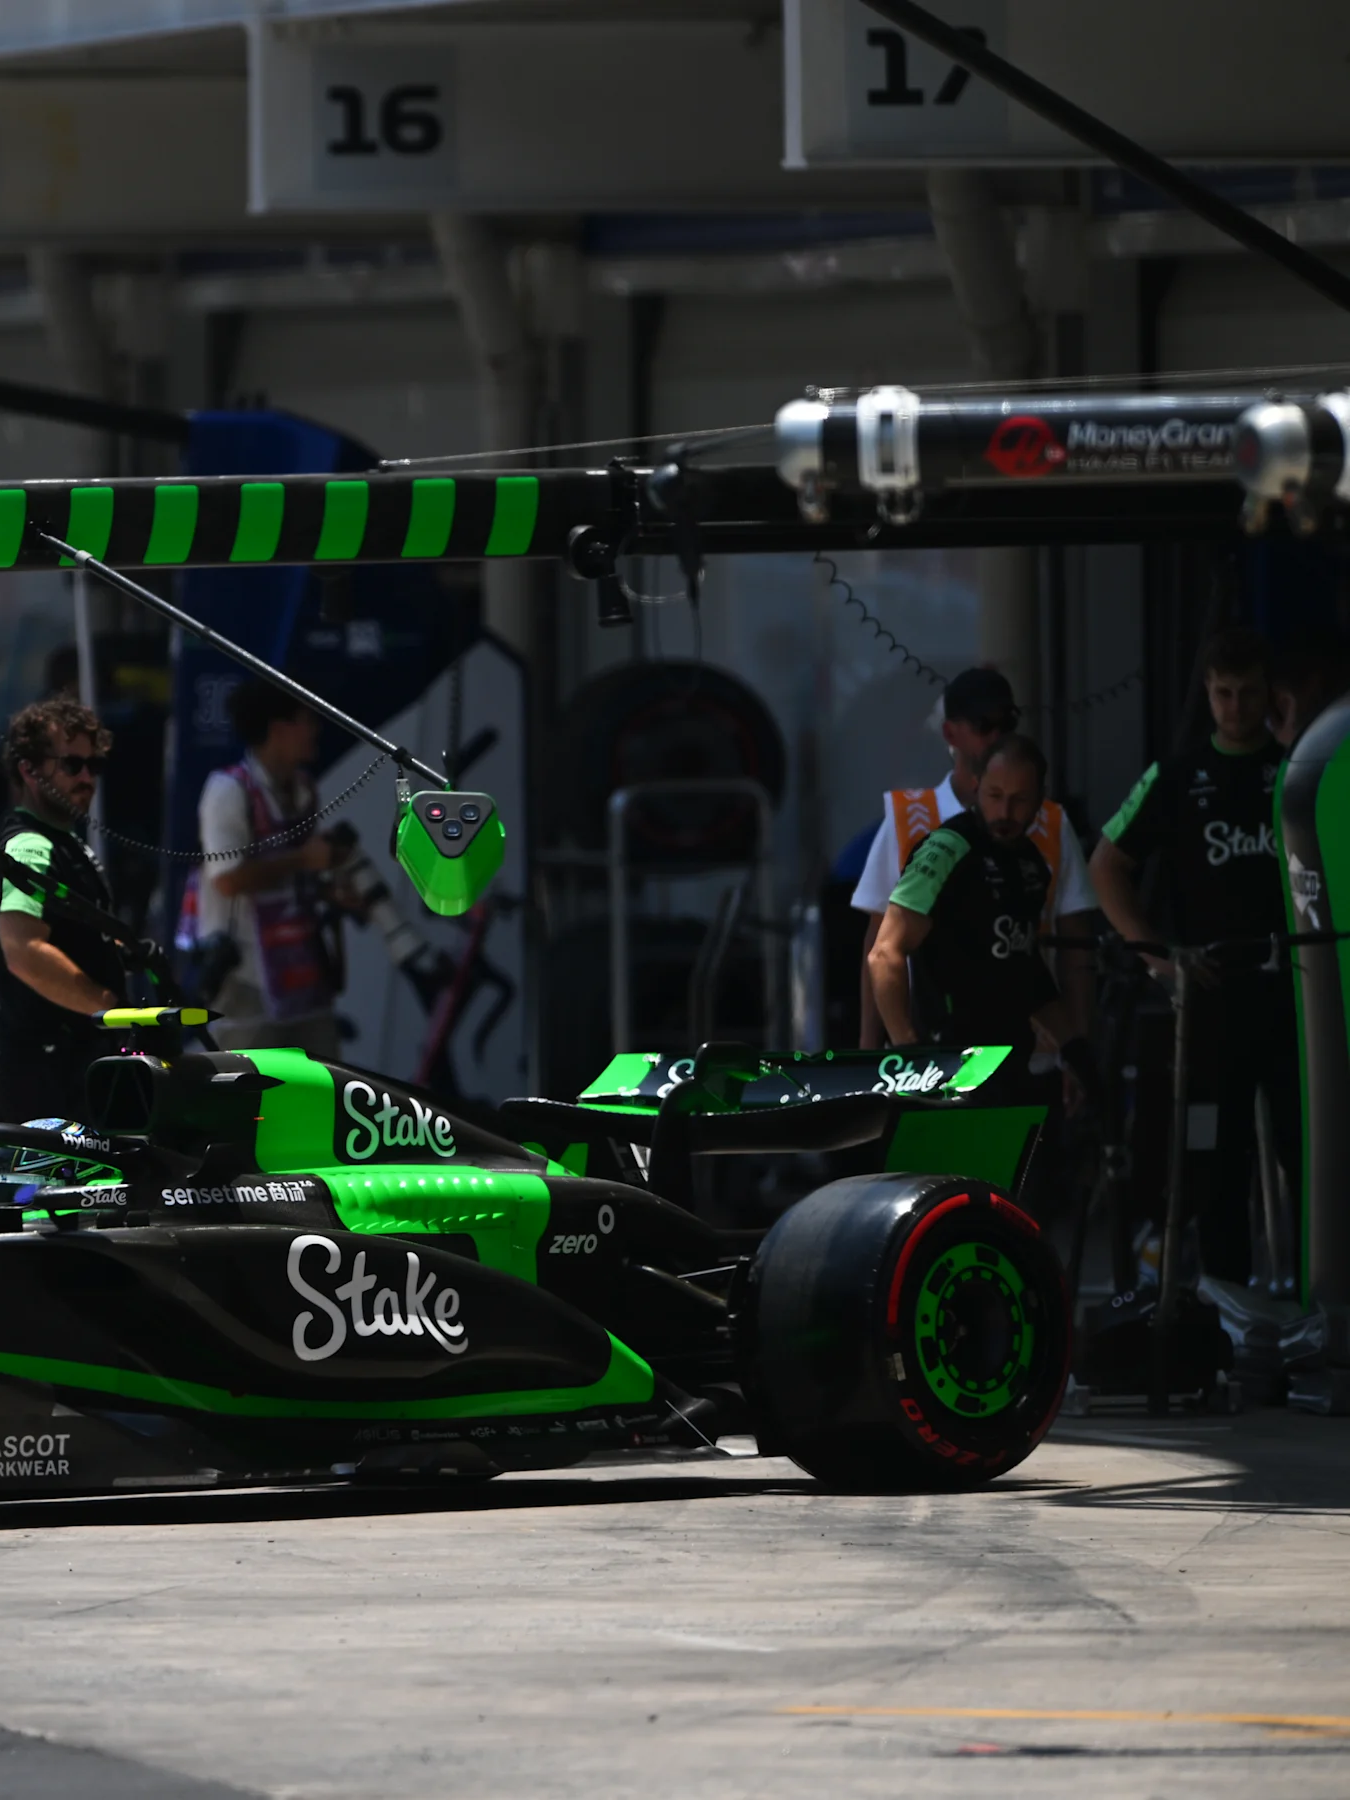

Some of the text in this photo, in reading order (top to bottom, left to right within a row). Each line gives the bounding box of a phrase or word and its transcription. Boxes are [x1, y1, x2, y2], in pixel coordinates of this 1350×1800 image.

[866, 26, 987, 106] 17
[327, 84, 443, 155] 16
[870, 1053, 946, 1095] Stake
[343, 1079, 457, 1161] Stake
[61, 1133, 111, 1153] Hyland
[81, 1185, 128, 1208] Stake
[161, 1183, 269, 1207] sensetime
[548, 1233, 599, 1255] zero
[286, 1234, 469, 1362] Stake
